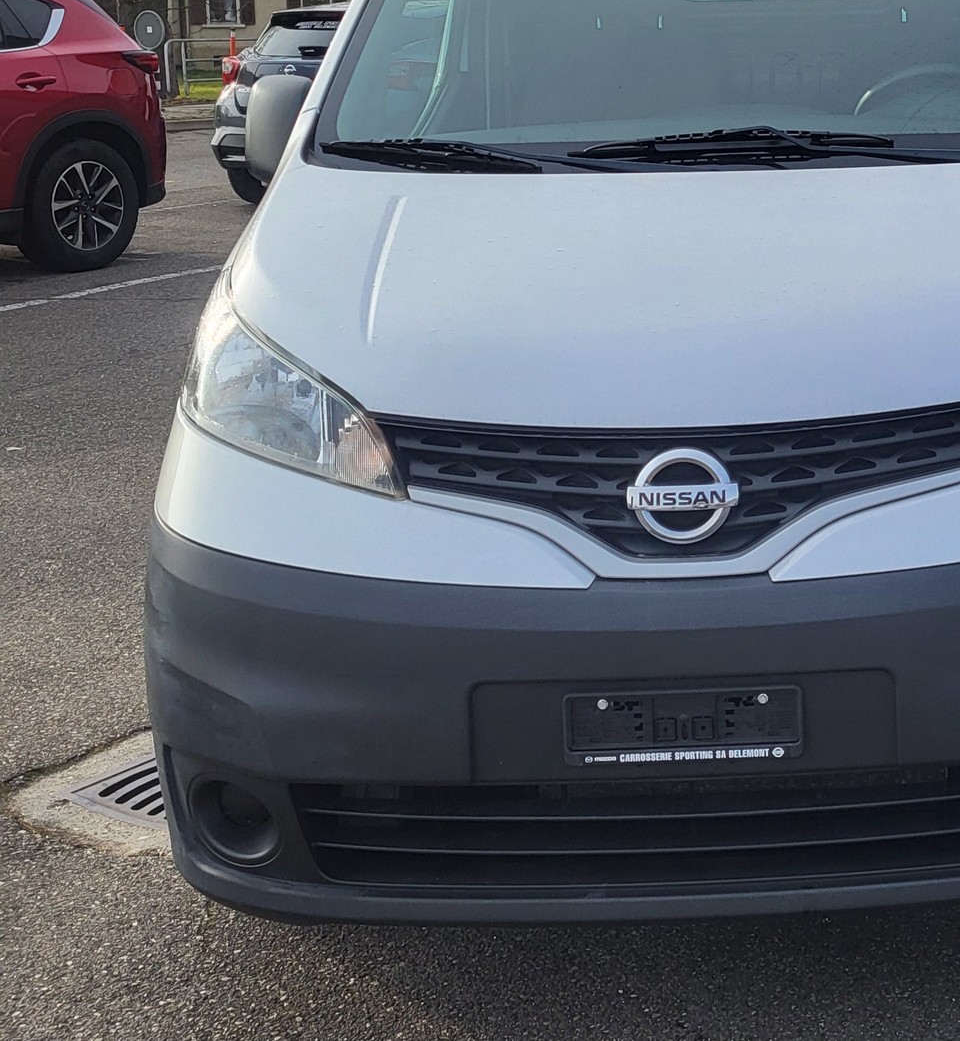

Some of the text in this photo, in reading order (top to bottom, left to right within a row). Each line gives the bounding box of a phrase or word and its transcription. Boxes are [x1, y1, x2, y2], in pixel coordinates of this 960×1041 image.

[639, 489, 726, 506] NISSAN
[620, 752, 673, 763] CARROSSERIE
[674, 751, 714, 761] SPORTING
[715, 750, 727, 759] SA
[728, 748, 770, 759] DELEMONT
